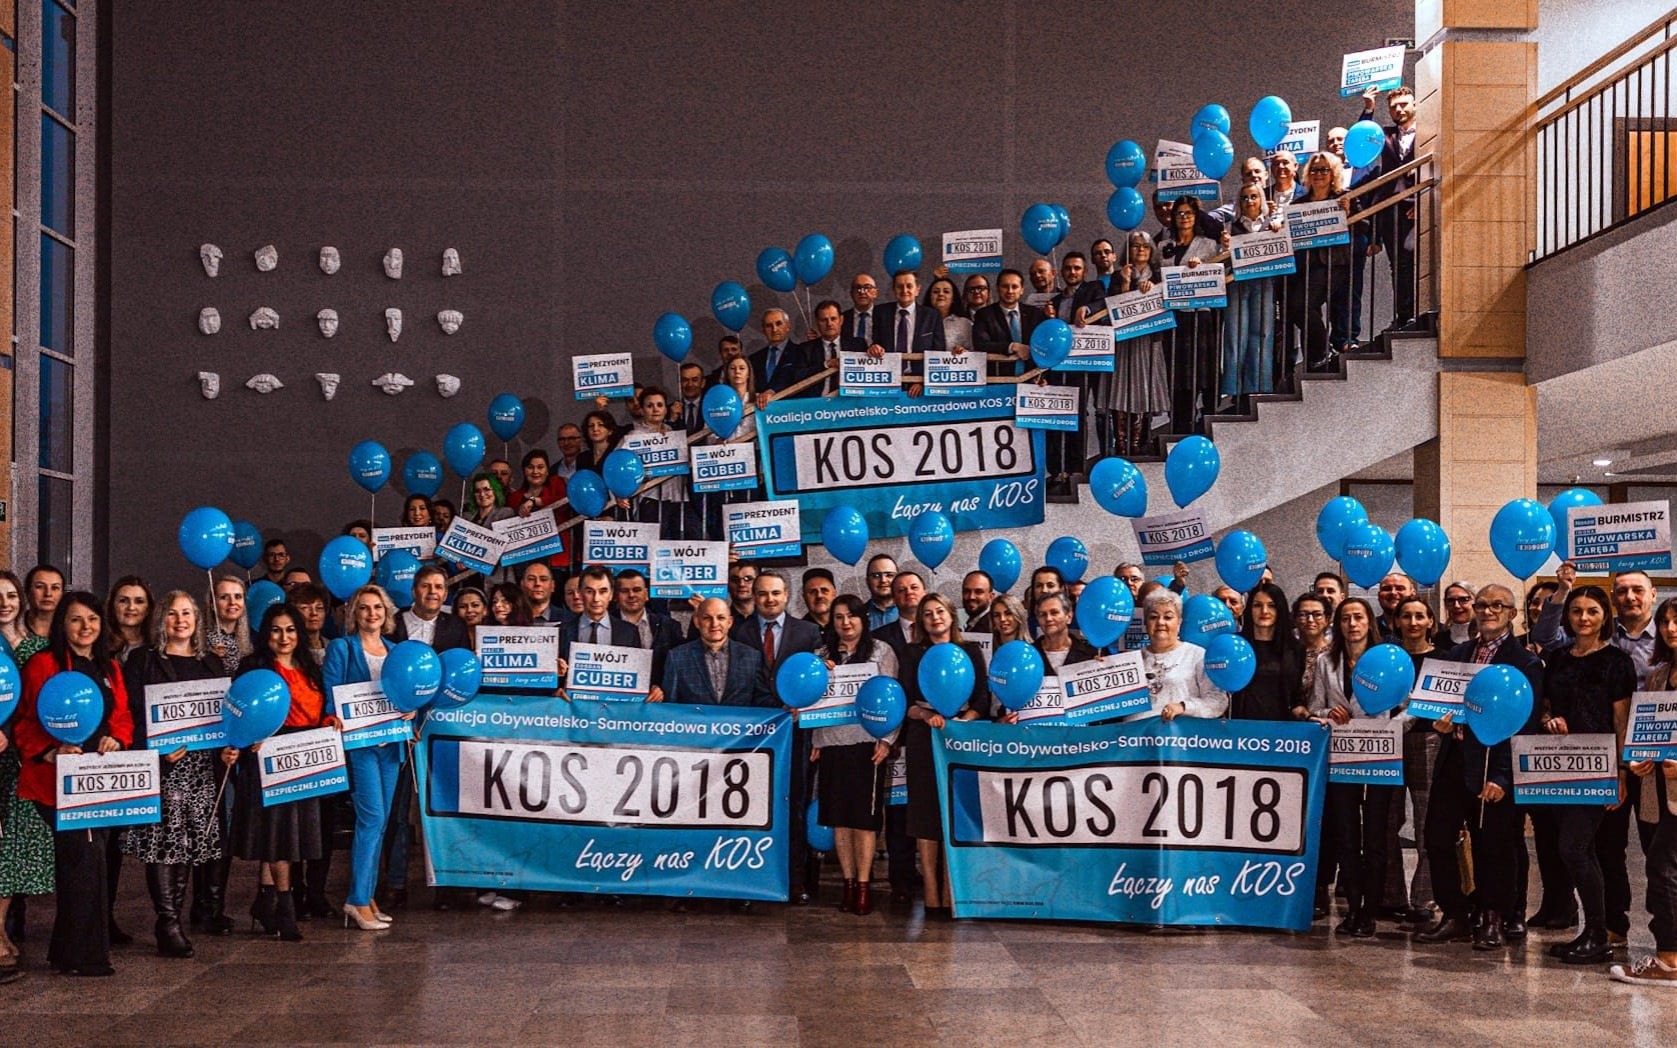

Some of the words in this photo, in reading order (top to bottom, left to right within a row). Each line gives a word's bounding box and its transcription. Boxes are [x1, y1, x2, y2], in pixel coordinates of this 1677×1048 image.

[1289, 126, 1317, 135] ZYDENT
[1169, 168, 1187, 179] KOS
[1302, 206, 1344, 217] BURMISTRZ
[954, 243, 971, 253] KOS
[973, 242, 994, 252] 2018
[1243, 246, 1260, 257] KOS
[1263, 243, 1285, 255] 2018
[1181, 269, 1222, 278] BURMISTRZ
[1235, 265, 1274, 276] BEZPIECZNEJ
[1274, 262, 1295, 271] DROGI
[1169, 282, 1216, 290] PIWOWARSKA
[1119, 305, 1139, 318] KOS
[1140, 299, 1163, 313] 2018
[1116, 322, 1153, 335] BEZPIECZNEJ
[1154, 317, 1173, 326] DROGI
[1085, 339, 1107, 349] 2018
[589, 358, 630, 368] PREZYDENT
[580, 375, 617, 385] KLIMA
[846, 373, 890, 383] CUBER
[930, 371, 975, 383] CUBER
[766, 412, 812, 424] Koalicja
[815, 400, 977, 422] Obywatelsko-Samorządowa
[980, 398, 1002, 408] KOS
[1005, 397, 1017, 407] 20
[1028, 400, 1045, 408] KOS
[1048, 400, 1070, 409] 2018
[1017, 417, 1056, 425] BEZPIECZNEJ
[642, 436, 669, 446] WÓJT
[709, 448, 736, 459] WÓJT
[813, 433, 895, 484] KOS
[912, 425, 1017, 477] 2018
[700, 464, 744, 477] CUBER
[950, 496, 981, 513] nas
[988, 478, 1039, 510] KOS
[744, 507, 796, 519] PREZYDENT
[1598, 511, 1664, 525] BURMISTRZ
[390, 532, 434, 541] PREZYDENT
[465, 529, 506, 547] PREZYDENT
[507, 532, 525, 543] KOS
[527, 525, 550, 538] 2018
[606, 526, 638, 538] WÓJT
[732, 528, 779, 543] KLIMA
[1149, 529, 1169, 543] KOS
[1172, 525, 1199, 540] 2018
[1577, 532, 1653, 544] PIWOWARSKA
[447, 536, 485, 557] KLIMA
[591, 547, 644, 559] CUBER
[673, 546, 707, 557] WÓJT
[1578, 545, 1616, 555] ZARĘBA
[502, 547, 540, 561] BEZPIECZNEJ
[1145, 552, 1187, 561] BEZPIECZNEJ
[1188, 547, 1213, 557] DROGI
[659, 566, 714, 579] CUBER
[499, 635, 556, 644] PREZYDENT
[484, 655, 535, 667] KLIMA
[594, 651, 628, 663] WÓJT
[576, 671, 633, 687] CUBER
[1077, 680, 1101, 693] KOS
[1104, 672, 1135, 687] 2018
[1435, 679, 1461, 693] KOS
[840, 683, 861, 696] 201
[1047, 694, 1062, 706] 20
[162, 706, 186, 719] KOS
[190, 702, 221, 716] 2018
[354, 702, 374, 716] KOS
[1067, 703, 1120, 718] BEZPIECZNEJ
[1121, 697, 1149, 708] DROGI
[427, 709, 487, 725] Koalicja
[490, 712, 707, 737] Obywatelsko-Samorządowa
[711, 722, 741, 735] KOS
[745, 722, 776, 736] 2018
[801, 711, 852, 721] BEZPIECZNEJ
[343, 730, 387, 741] BEZPIECZNEJ
[388, 725, 411, 736] DROGI
[1636, 722, 1677, 731] PIWOWA
[150, 735, 204, 747] BEZPIECZNEJ
[205, 731, 227, 741] DRO
[1634, 734, 1670, 742] ZARĘBA
[945, 737, 1003, 754] Koalicja
[1006, 735, 1233, 758] Obywatelsko-Samorządowa
[1237, 738, 1271, 752] KOS
[1275, 739, 1311, 754] 2018
[1332, 739, 1355, 752] KOS
[1359, 739, 1390, 753] 2018
[276, 756, 301, 770] KOS
[305, 749, 333, 765] 2018
[1534, 756, 1562, 770] KOS
[1567, 756, 1603, 770] 2018
[1329, 767, 1371, 776] ZPIECZNEJ
[1373, 769, 1400, 777] DROGI
[78, 775, 105, 792] KOS
[111, 773, 146, 790] 2018
[265, 780, 318, 798] BEZPIECZNEJ
[319, 775, 346, 786] DROGI
[483, 749, 589, 815] KOS
[613, 755, 750, 819] 2018
[1518, 788, 1580, 796] BEZPIECZNEJ
[1584, 788, 1616, 796] DROGI
[60, 809, 124, 821] BEZPIECZNEJ
[126, 806, 157, 816] DROGI
[1004, 772, 1117, 839] KOS
[1141, 772, 1282, 842] 2018
[575, 839, 643, 881] Łączy
[654, 850, 694, 869] nas
[704, 836, 774, 871] KOS
[1108, 862, 1173, 909] Łączy
[1183, 874, 1221, 895] nas
[1230, 859, 1305, 896] KOS
